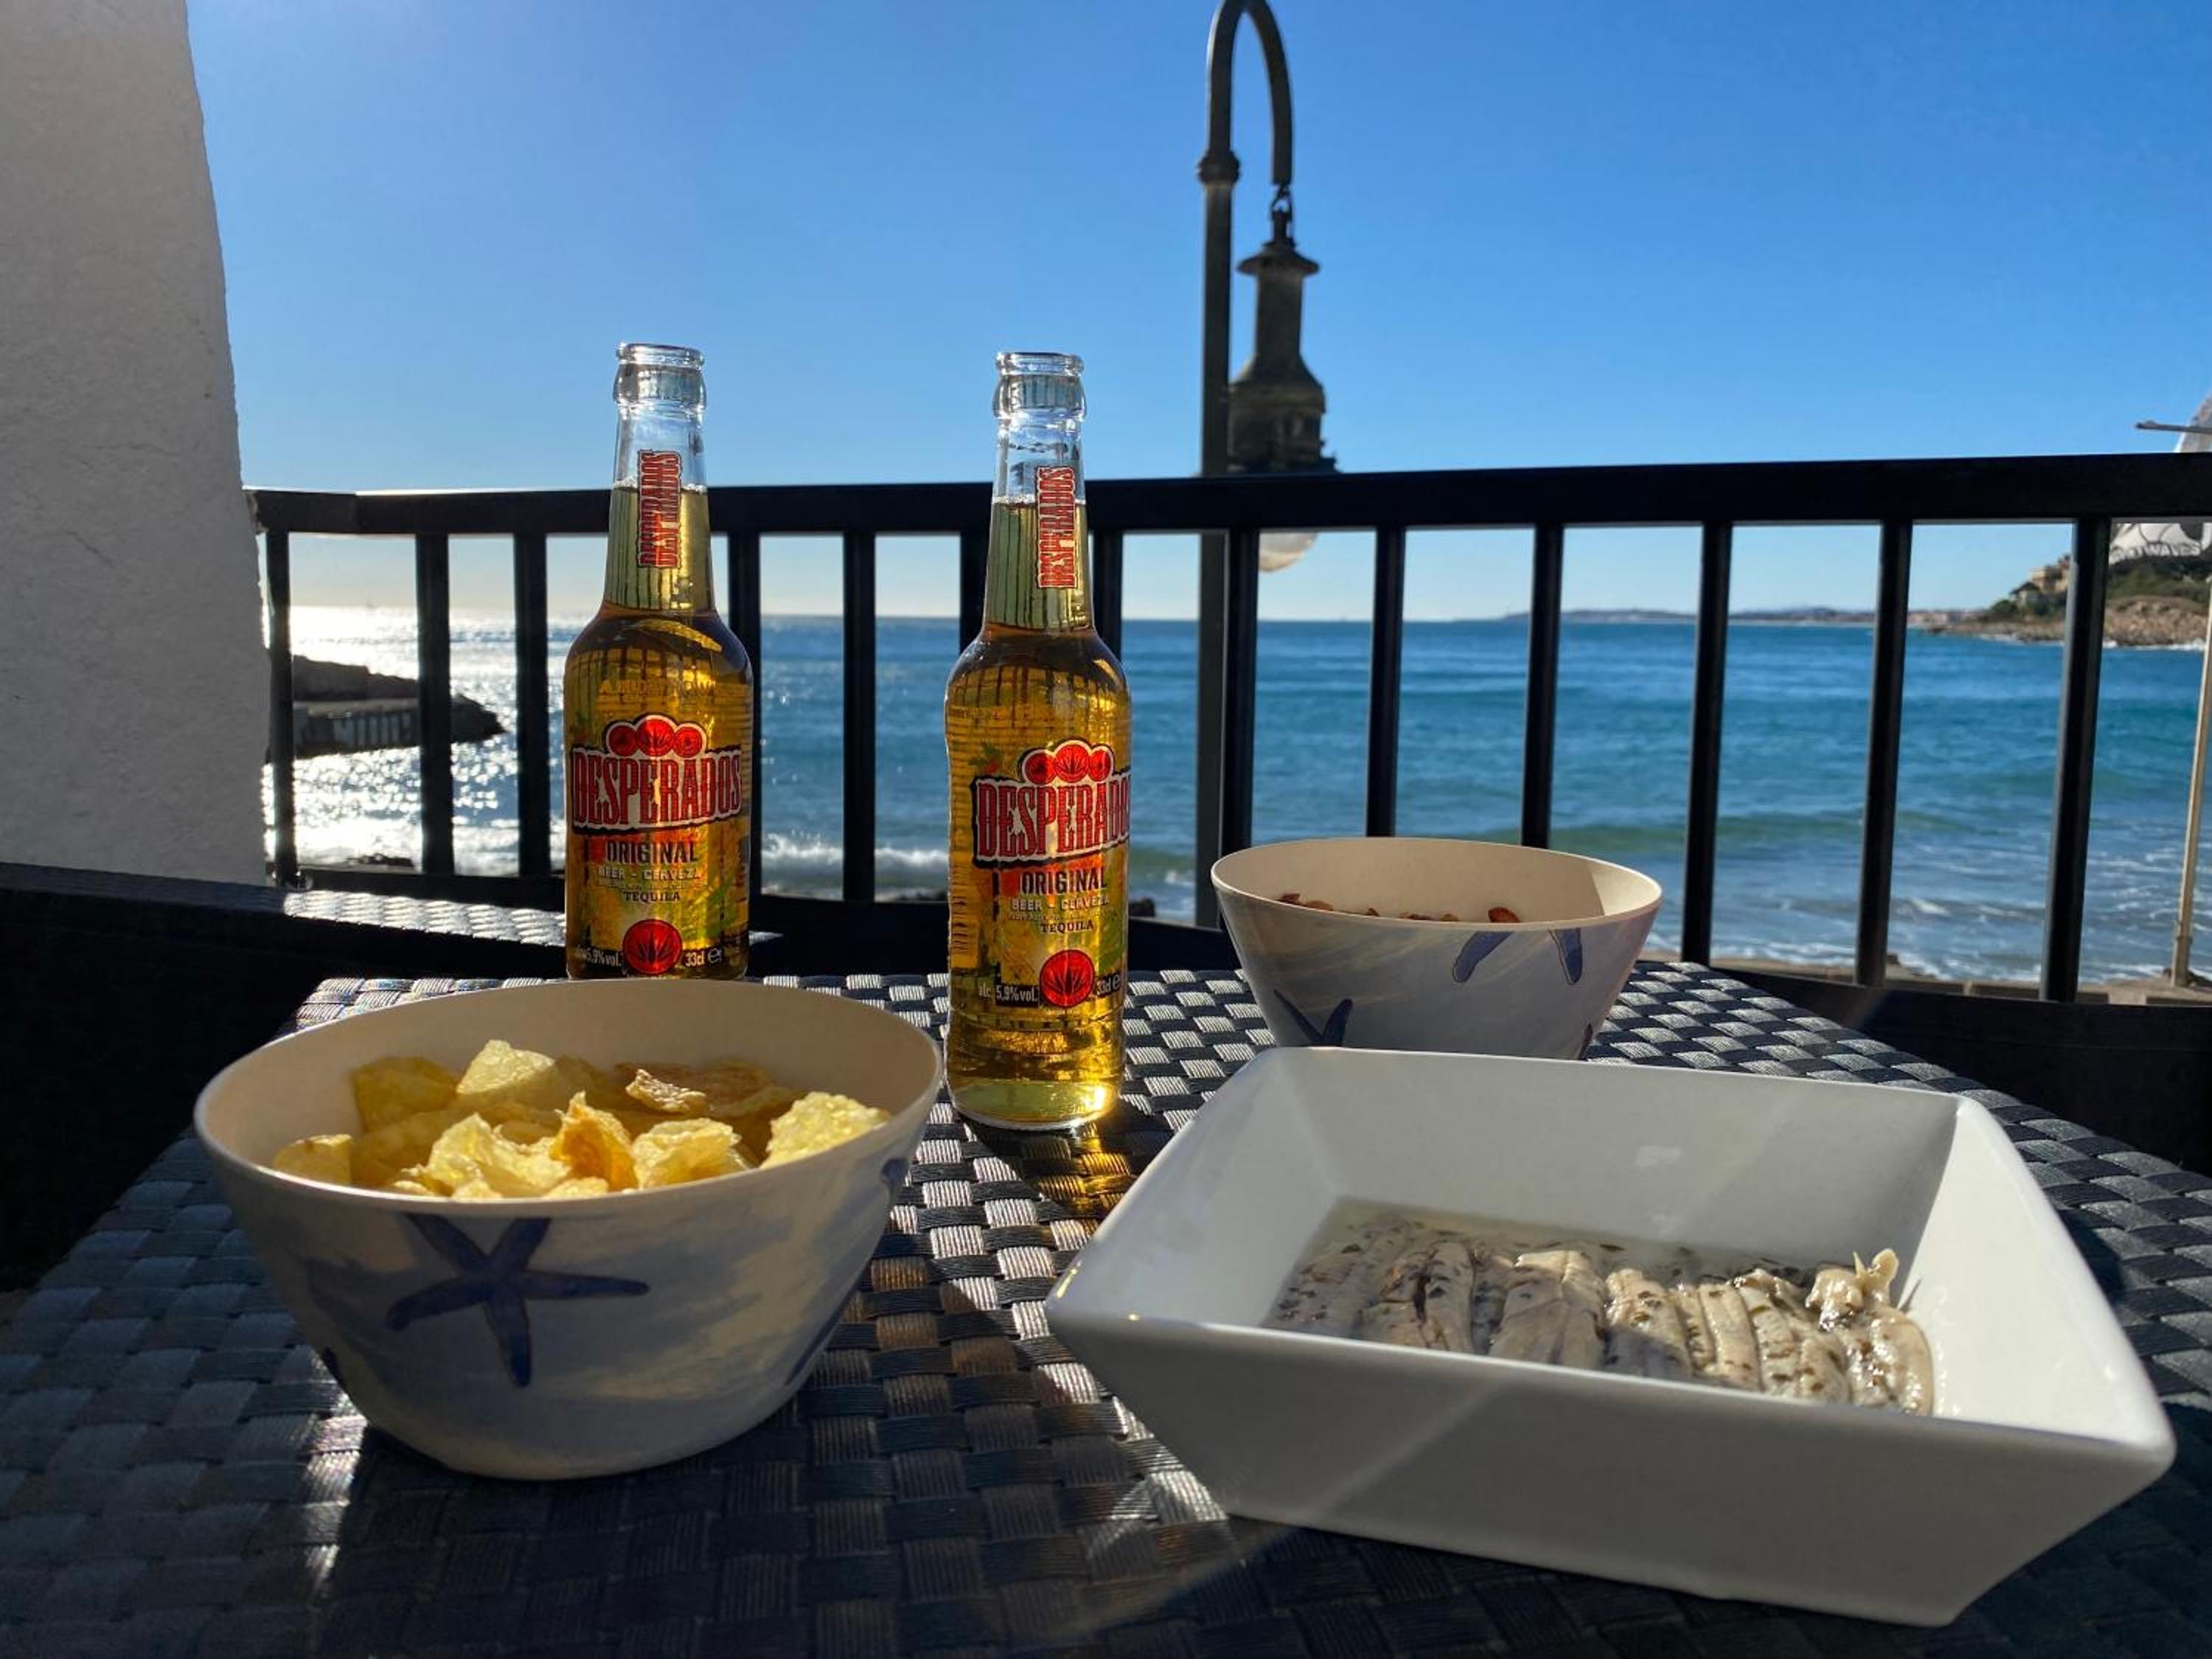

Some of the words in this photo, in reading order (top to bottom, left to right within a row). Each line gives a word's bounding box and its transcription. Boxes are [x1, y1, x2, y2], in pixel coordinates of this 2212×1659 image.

[574, 752, 740, 824] DESPERADOS
[977, 776, 1130, 857] DESPERADO
[606, 841, 698, 865] ORIGINAL
[1021, 866, 1108, 895] ORIGINAL
[625, 891, 681, 903] TEQUILA
[1012, 898, 1043, 911] BEER
[1040, 920, 1094, 933] TEQUILA
